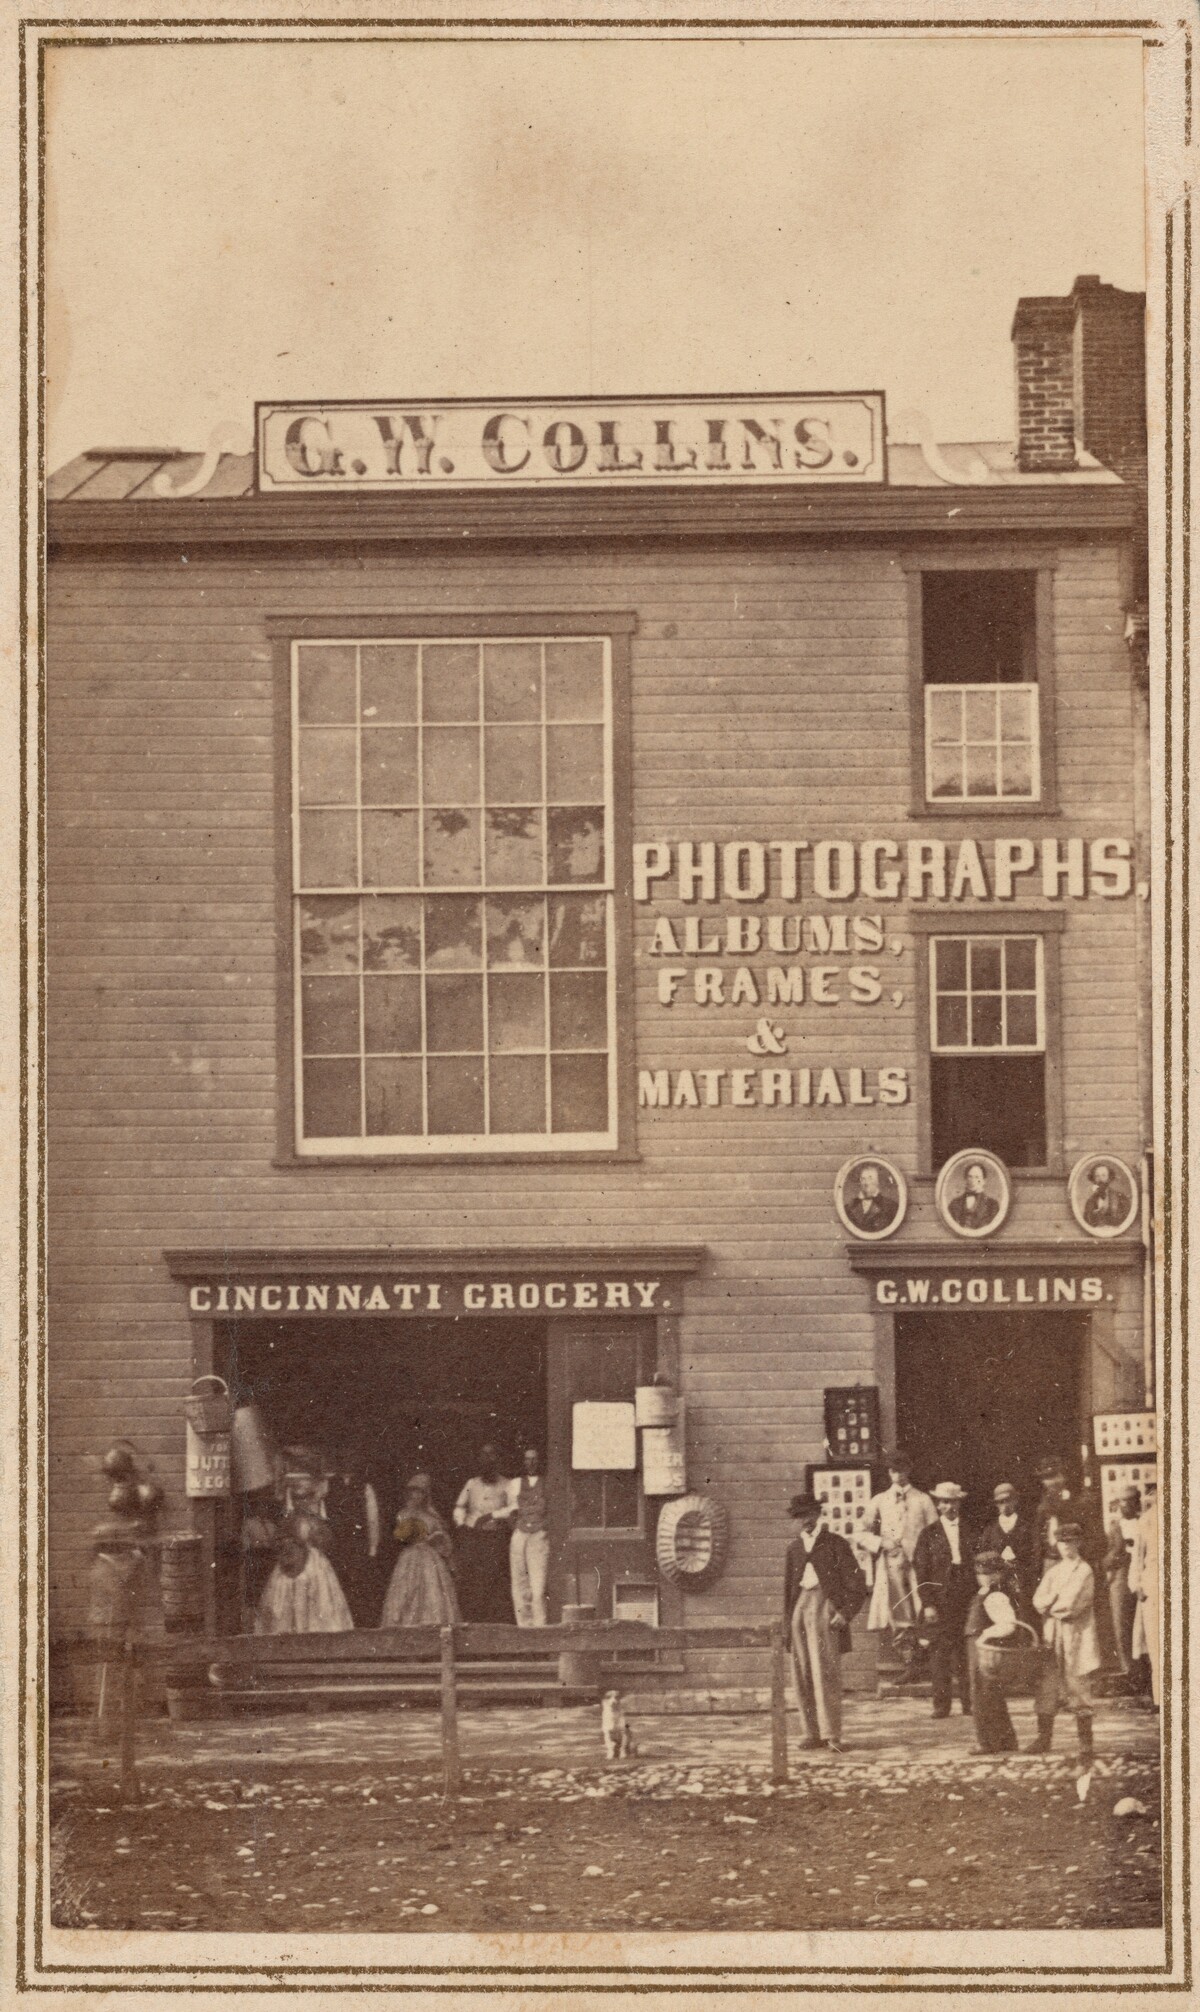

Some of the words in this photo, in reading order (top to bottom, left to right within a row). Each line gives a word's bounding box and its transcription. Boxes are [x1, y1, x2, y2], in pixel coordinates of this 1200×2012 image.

[482, 413, 861, 475] COLLINS.
[632, 837, 1150, 901] PHOTOGRAPHS,
[648, 914, 903, 956] ALBUMS,
[658, 965, 903, 1008] FRAMES,
[746, 1017, 787, 1056] &
[638, 1066, 909, 1107] MATERIALS
[189, 1284, 442, 1311] CINCINNATI
[463, 1282, 672, 1309] GROCERY.
